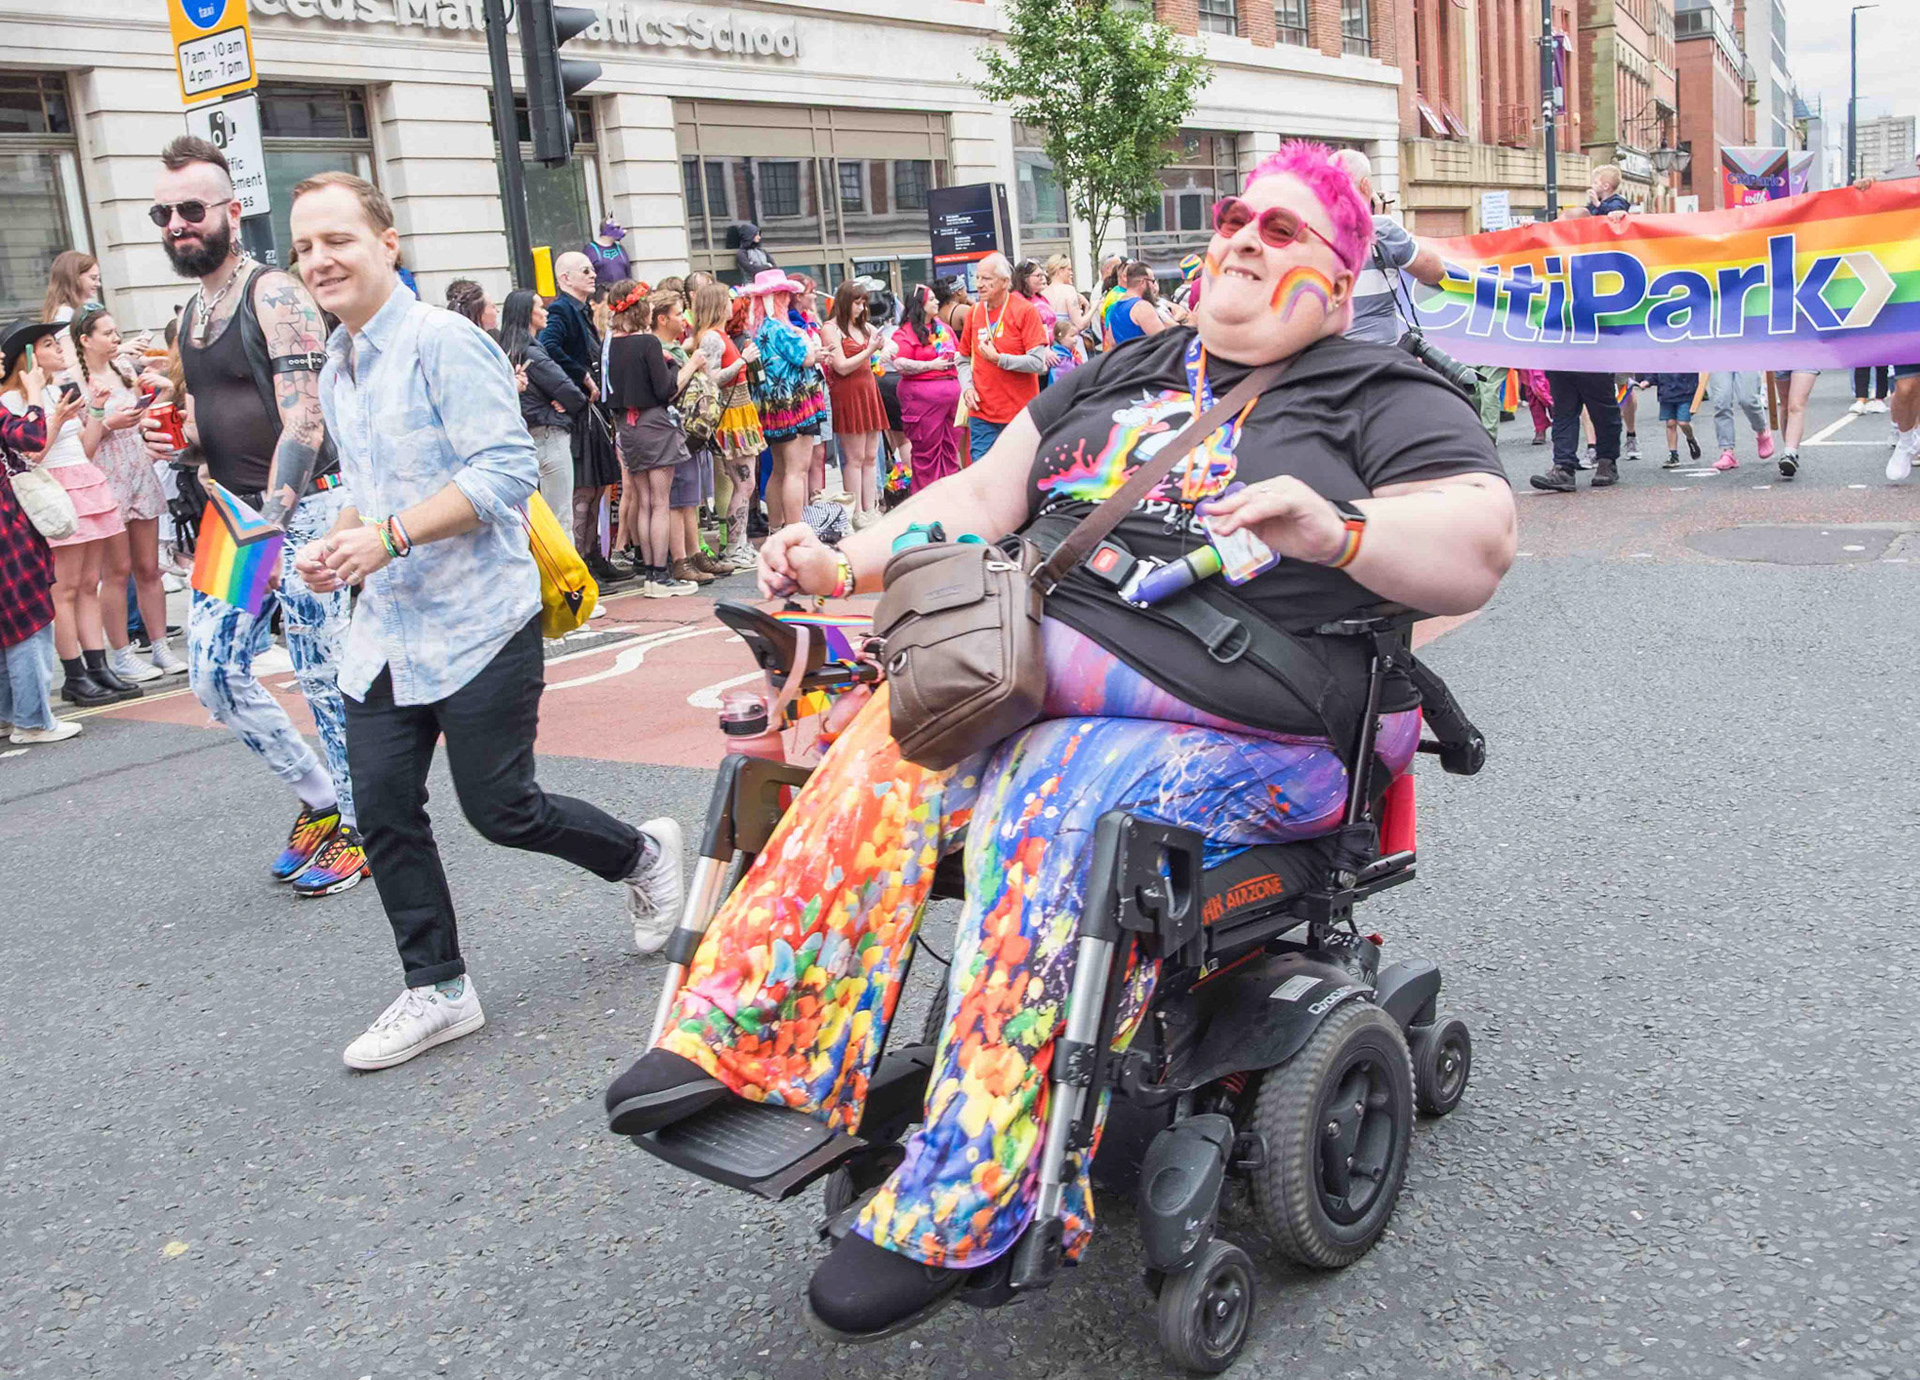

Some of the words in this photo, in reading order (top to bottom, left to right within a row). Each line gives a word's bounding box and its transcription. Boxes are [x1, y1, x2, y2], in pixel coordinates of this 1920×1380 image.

[199, 3, 215, 18] taxi
[687, 8, 806, 58] School
[183, 52, 190, 66] 7
[191, 51, 206, 63] am
[213, 42, 225, 57] 10
[227, 41, 242, 54] am
[189, 70, 196, 82] 4
[198, 69, 213, 84] pm
[219, 61, 225, 76] 7
[227, 61, 243, 77] pm
